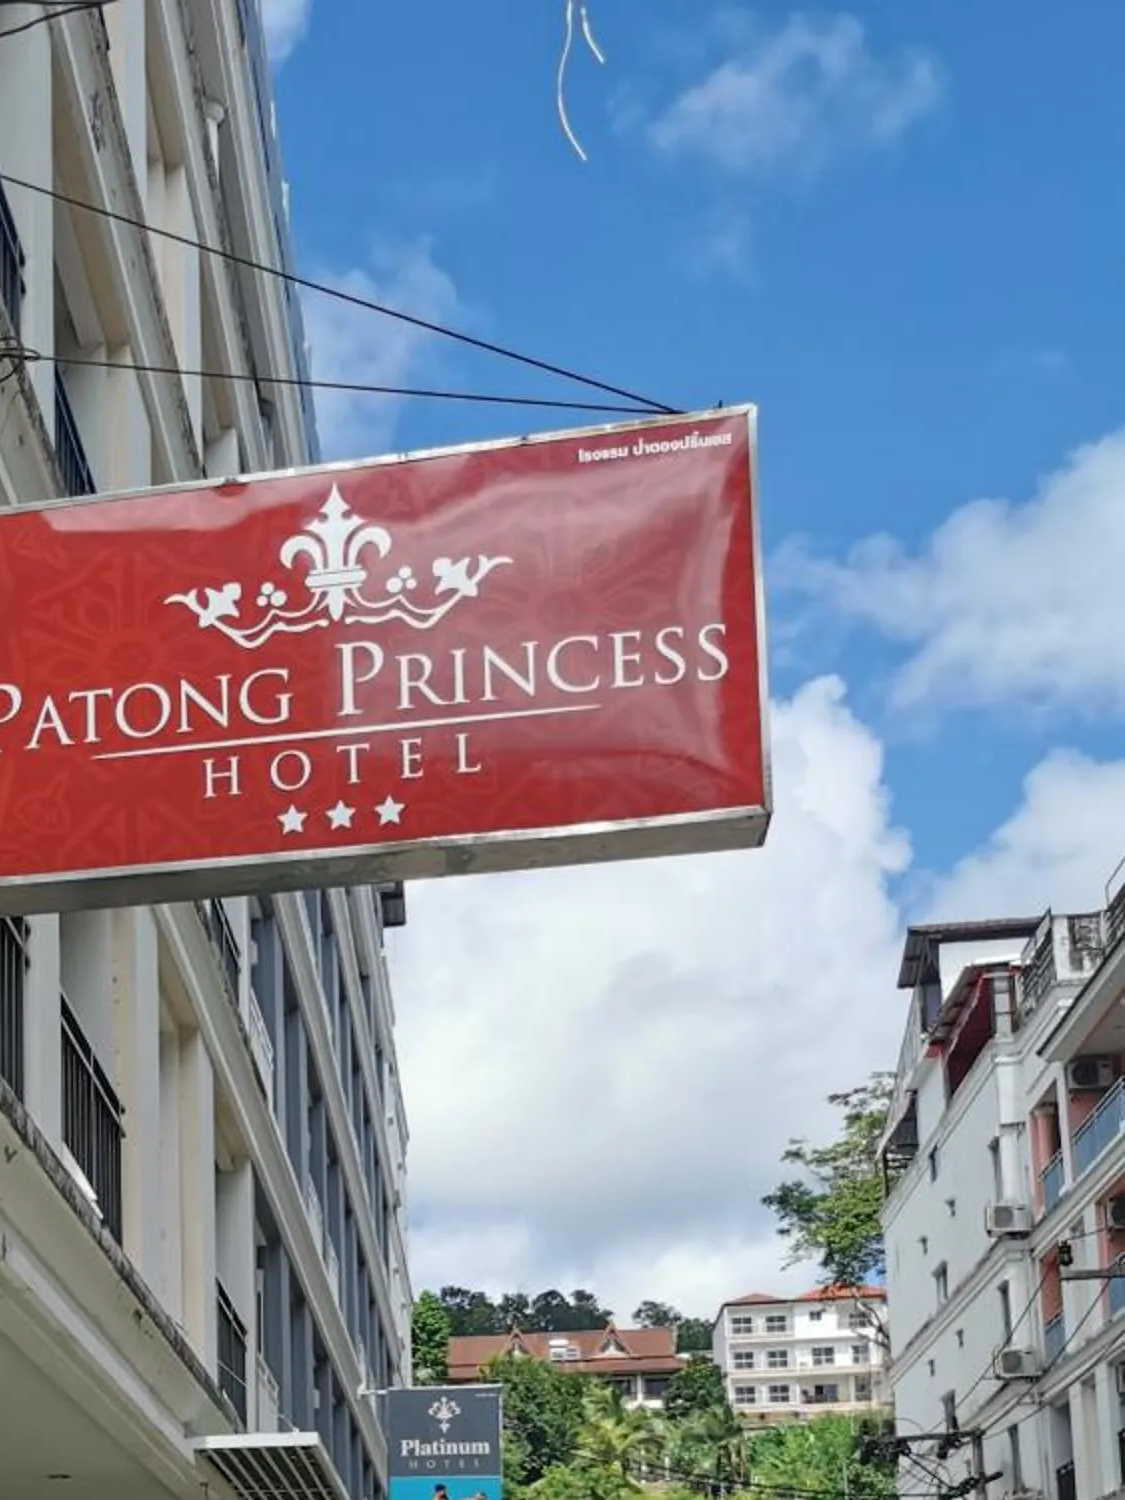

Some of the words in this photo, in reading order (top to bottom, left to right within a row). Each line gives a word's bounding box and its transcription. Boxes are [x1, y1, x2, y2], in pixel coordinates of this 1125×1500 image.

[335, 622, 731, 719] PRINCESS
[202, 733, 484, 799] HOTEL
[400, 1438, 490, 1458] Platinum
